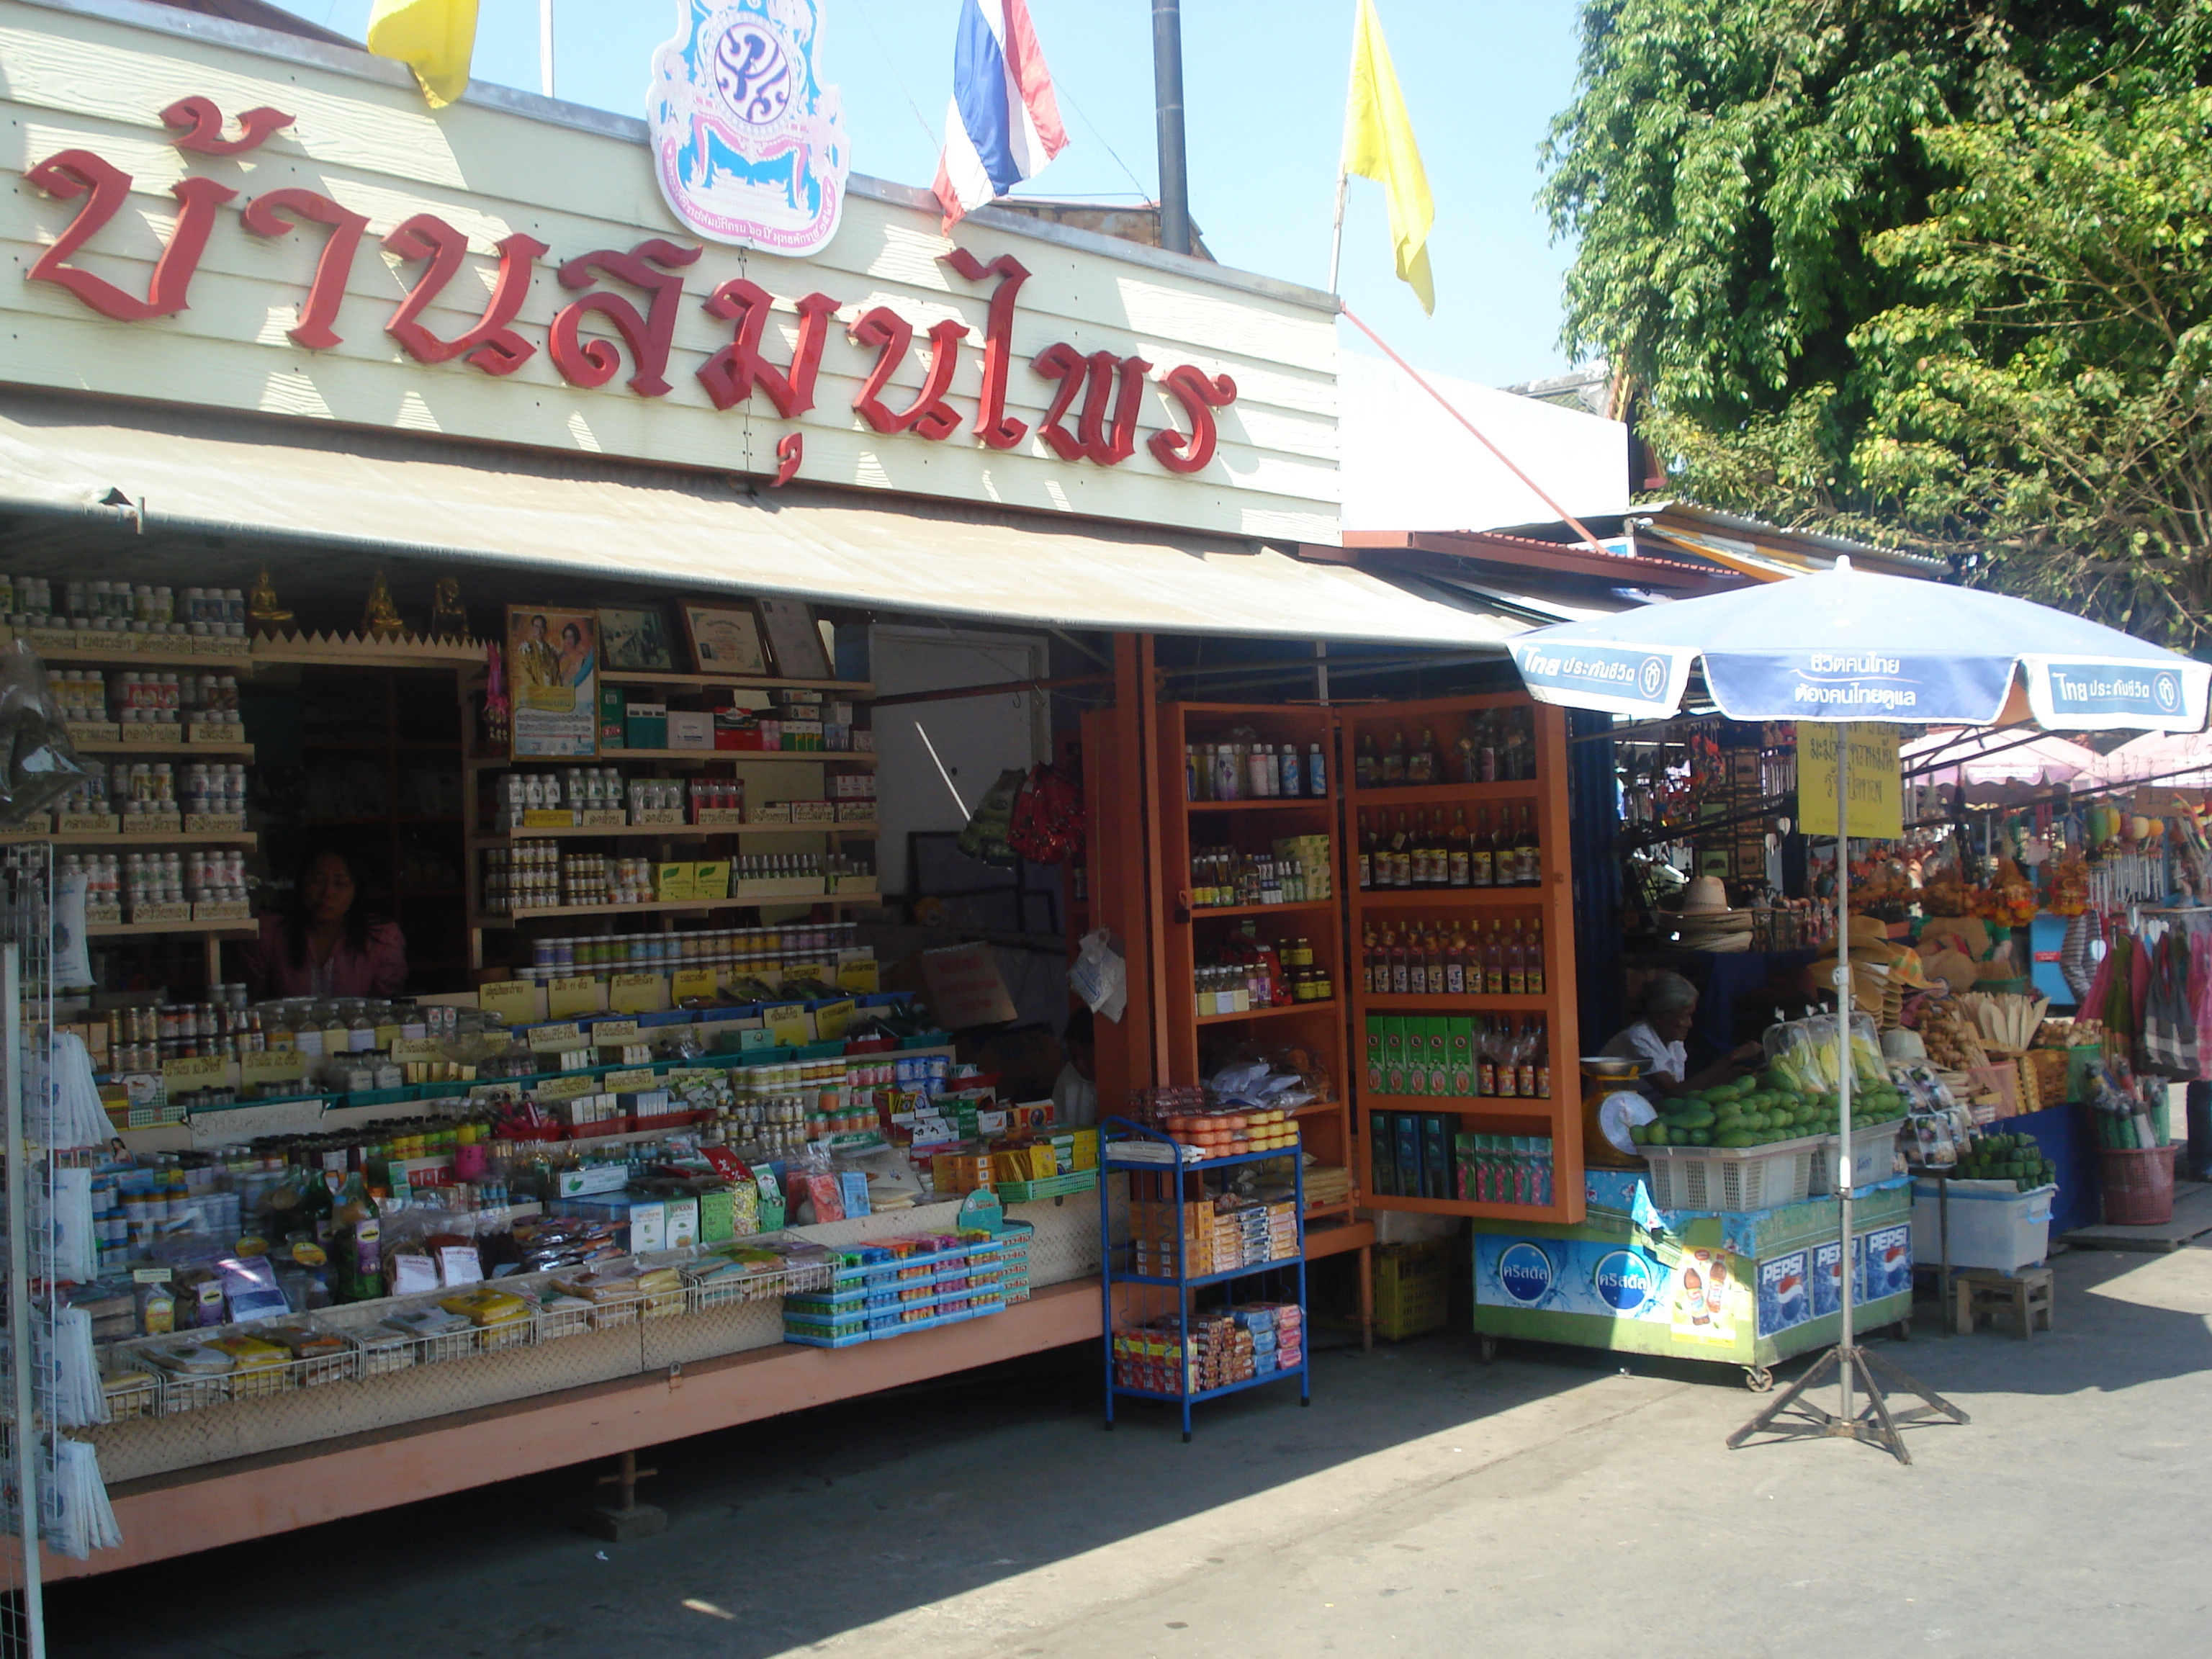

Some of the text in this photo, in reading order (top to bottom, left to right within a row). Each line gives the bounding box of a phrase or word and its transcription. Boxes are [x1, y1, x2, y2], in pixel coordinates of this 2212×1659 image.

[24, 95, 1237, 487] บ้านสมุนไพร
[1522, 646, 1636, 682] ไทย ประกันชีวิต
[1810, 651, 1900, 674] ชีวิตคนไทย
[1794, 682, 1917, 710] ต้องคนไทยดูแล
[2052, 672, 2150, 701] ไทย ประกันชีวิต
[603, 727, 621, 737] ENO
[1817, 1238, 1858, 1268] PEPI
[1869, 1227, 1908, 1254] PEPSI
[1503, 1264, 1549, 1284] คริสตัล
[1599, 1272, 1648, 1295] คริสตัล
[1762, 1254, 1804, 1285] PEPSI
